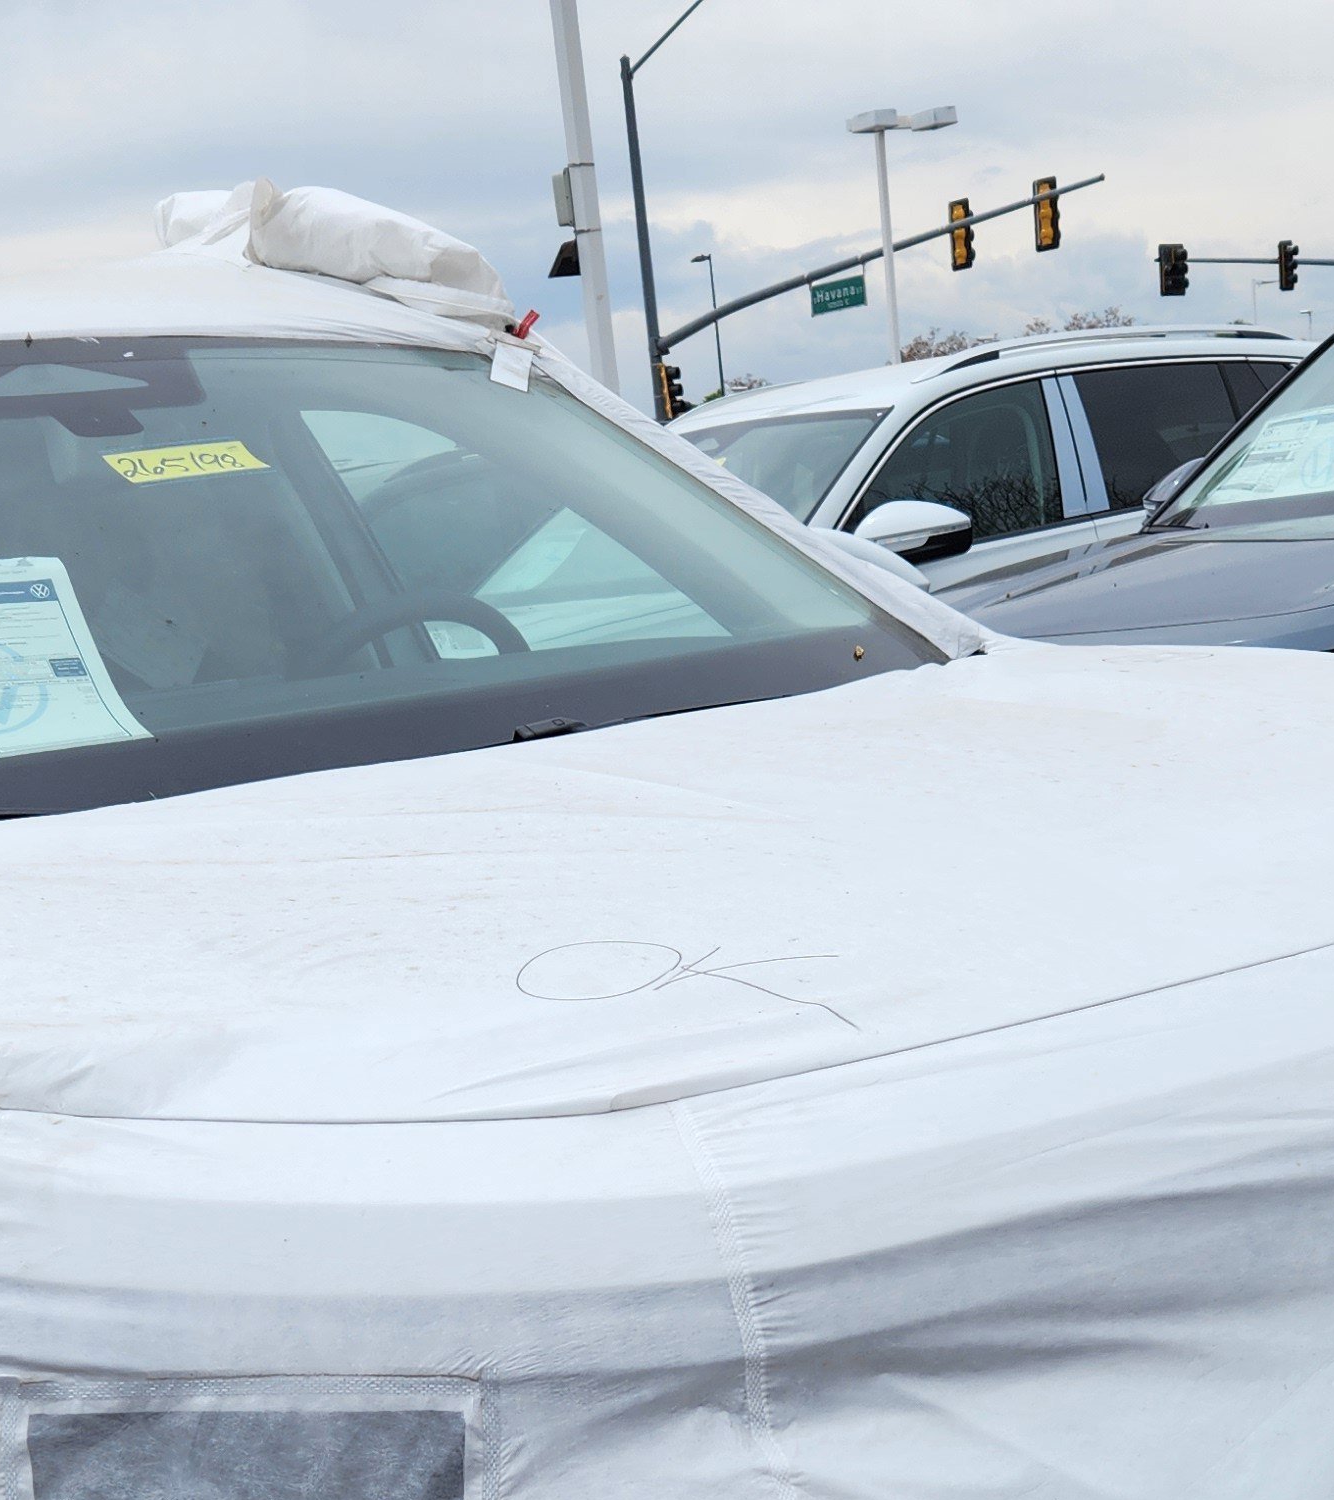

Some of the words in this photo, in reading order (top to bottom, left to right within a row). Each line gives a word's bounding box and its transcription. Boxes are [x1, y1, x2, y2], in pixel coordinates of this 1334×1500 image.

[816, 286, 855, 302] Havana
[117, 450, 245, 478] 265198
[516, 940, 860, 1031] OK
